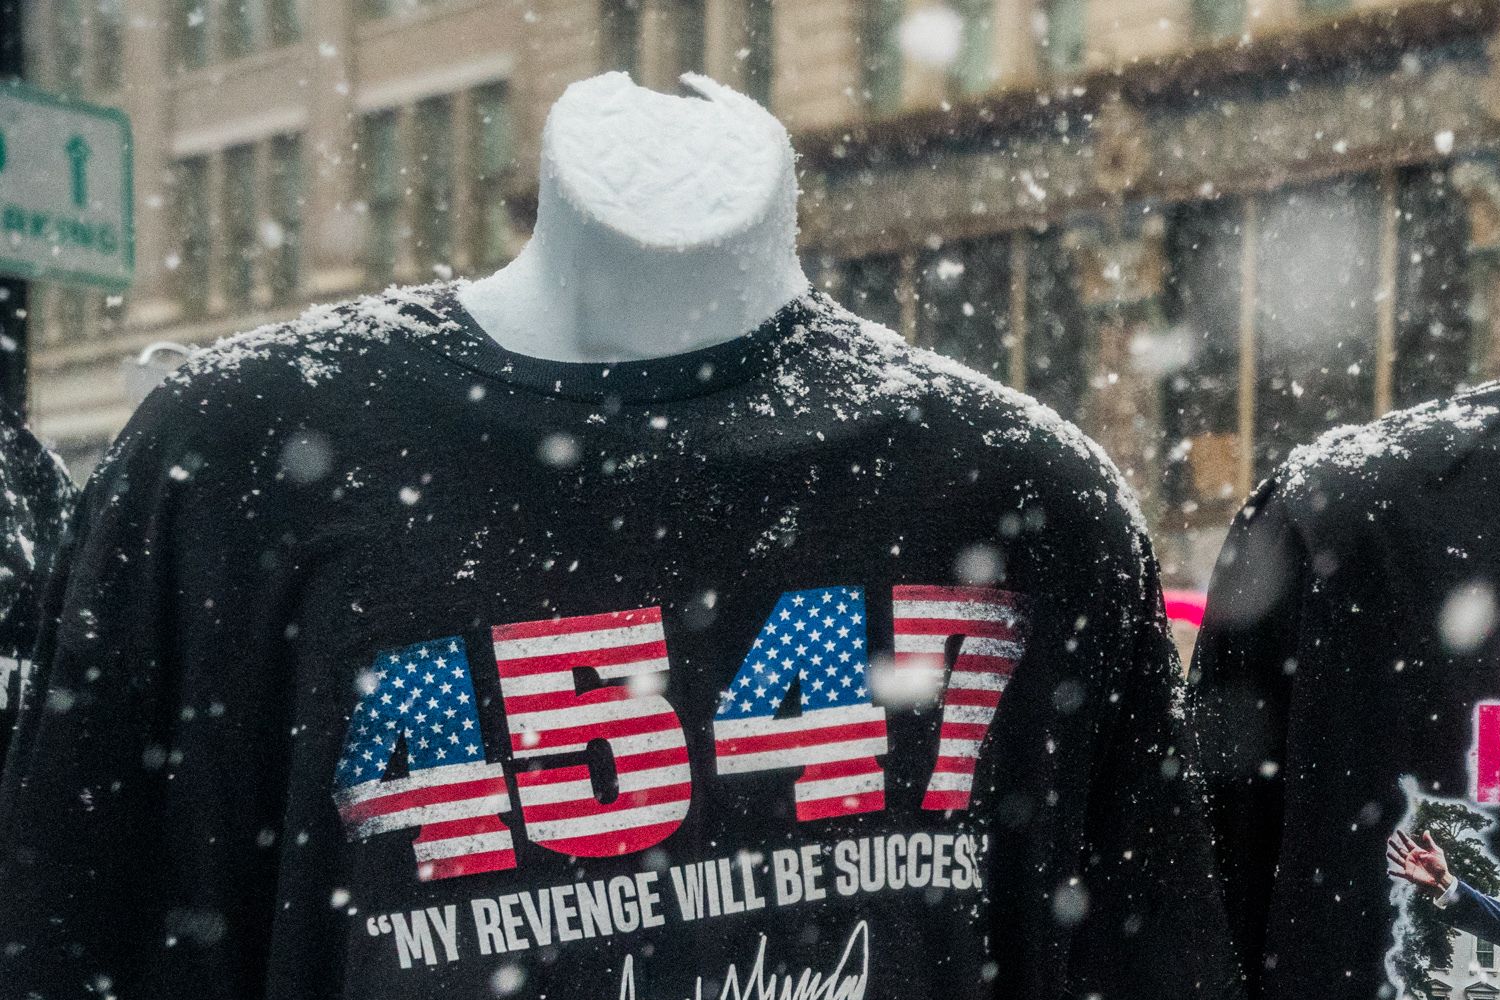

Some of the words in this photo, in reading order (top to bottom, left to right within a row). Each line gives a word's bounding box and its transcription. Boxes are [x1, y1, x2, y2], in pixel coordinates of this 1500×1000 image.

[332, 605, 692, 882] 45
[713, 584, 1030, 823] 47
[367, 902, 459, 970] "MY
[470, 870, 665, 956] REVENGE
[669, 855, 766, 922] WILL
[773, 844, 828, 907] BE
